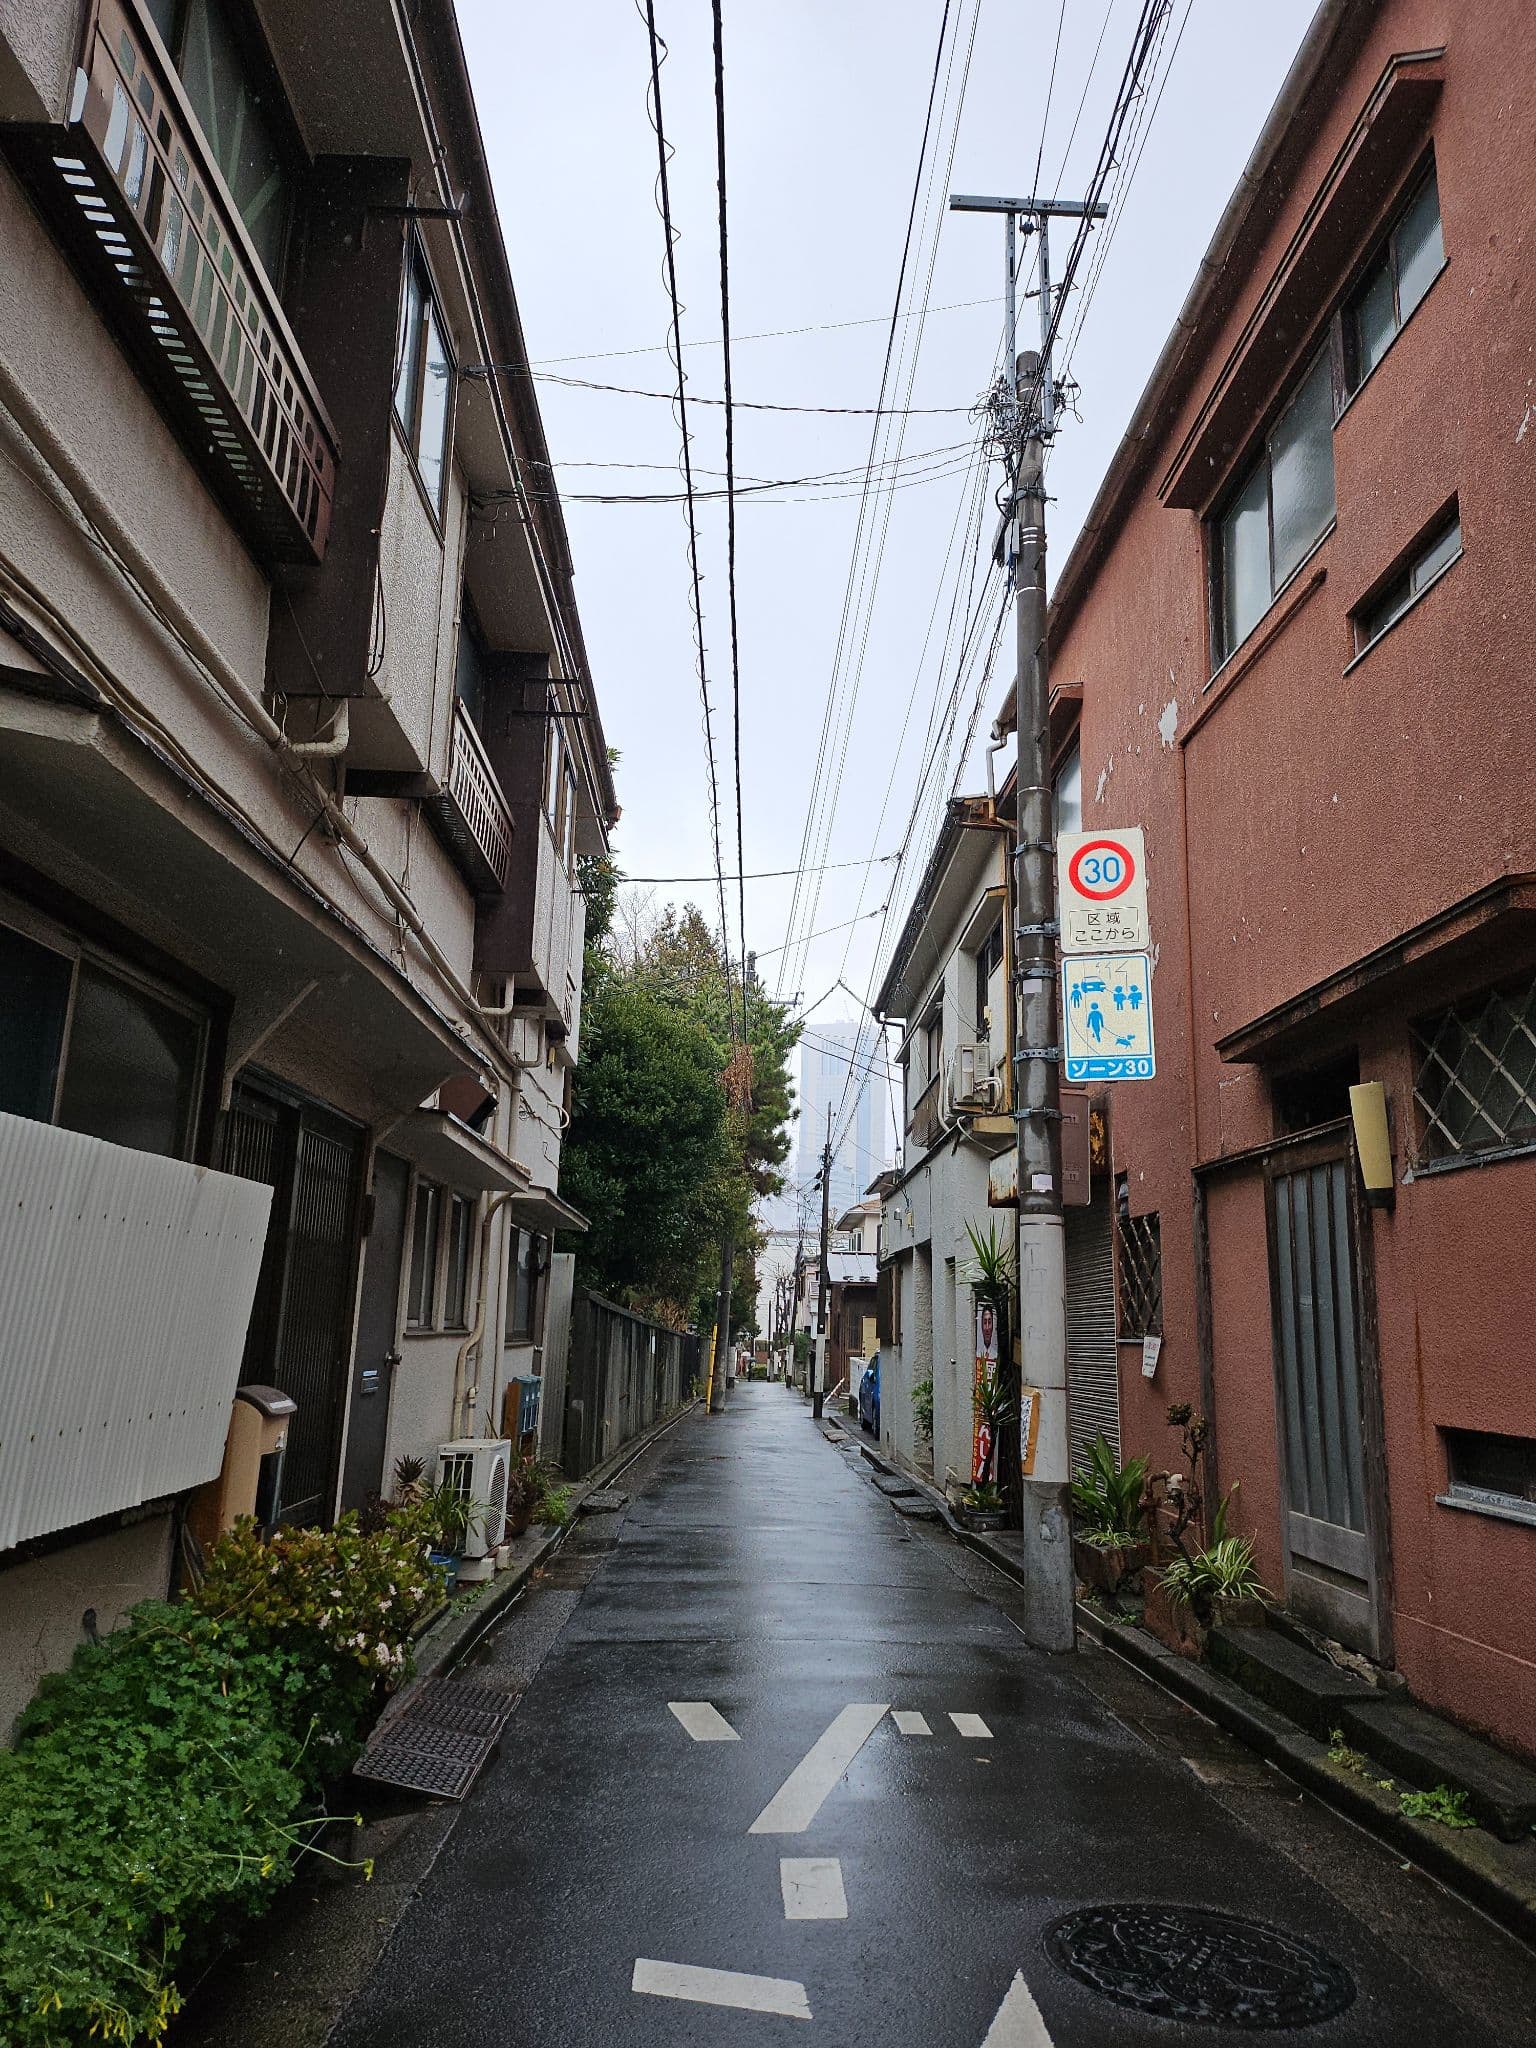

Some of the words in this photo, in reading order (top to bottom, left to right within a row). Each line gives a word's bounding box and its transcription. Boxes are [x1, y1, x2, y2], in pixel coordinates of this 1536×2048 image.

[1084, 857, 1121, 884] 30
[1087, 911, 1121, 926] 区域
[1075, 927, 1135, 942] ここから
[1071, 1059, 1149, 1077] ゾーン30
